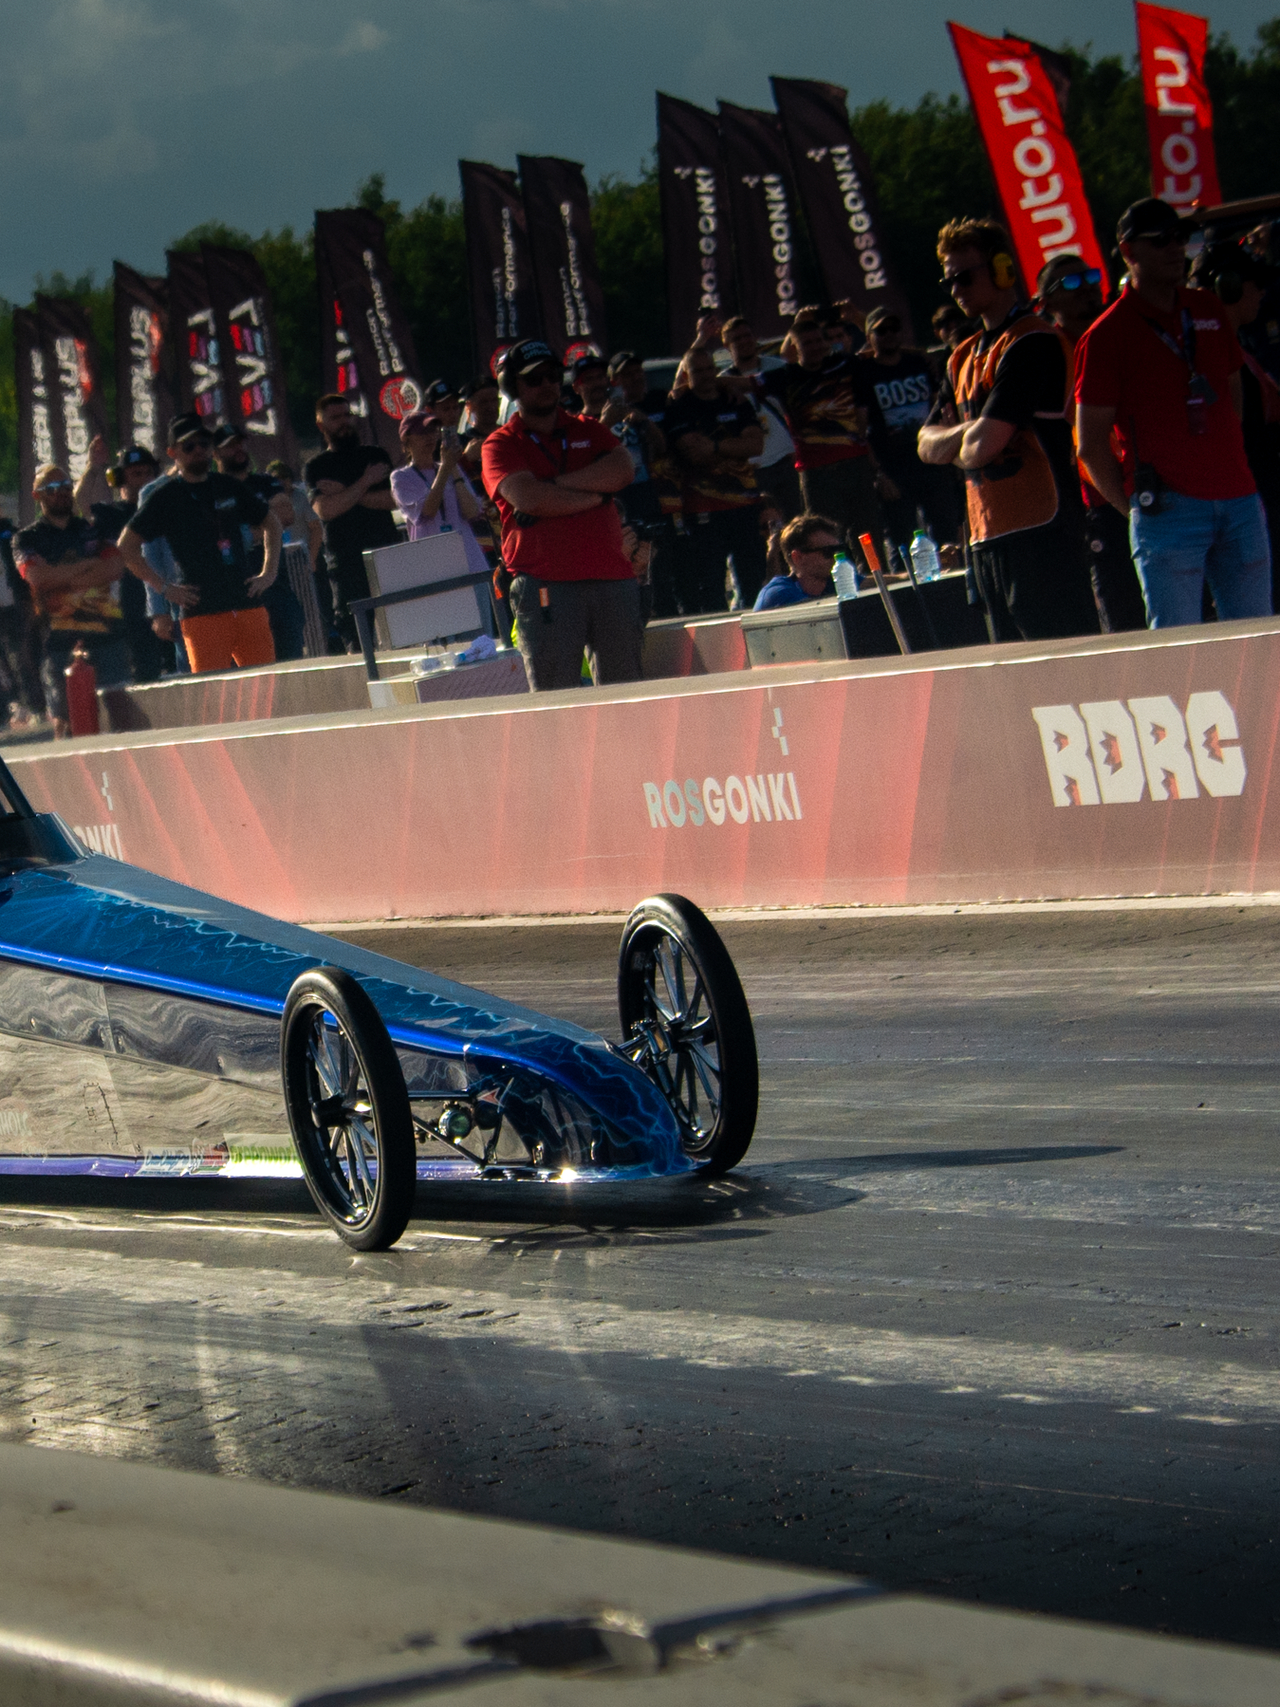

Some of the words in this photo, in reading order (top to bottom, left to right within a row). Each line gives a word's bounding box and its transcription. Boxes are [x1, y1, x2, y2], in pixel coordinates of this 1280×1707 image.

[1152, 46, 1204, 218] to.ru
[694, 166, 720, 310] ROSGONKI
[762, 173, 797, 317] ROSGONKI
[830, 144, 888, 290] ROSGONKI
[873, 374, 931, 411] BOSS
[643, 772, 803, 829] ROSGONKI
[1032, 690, 1247, 808] RDRC
